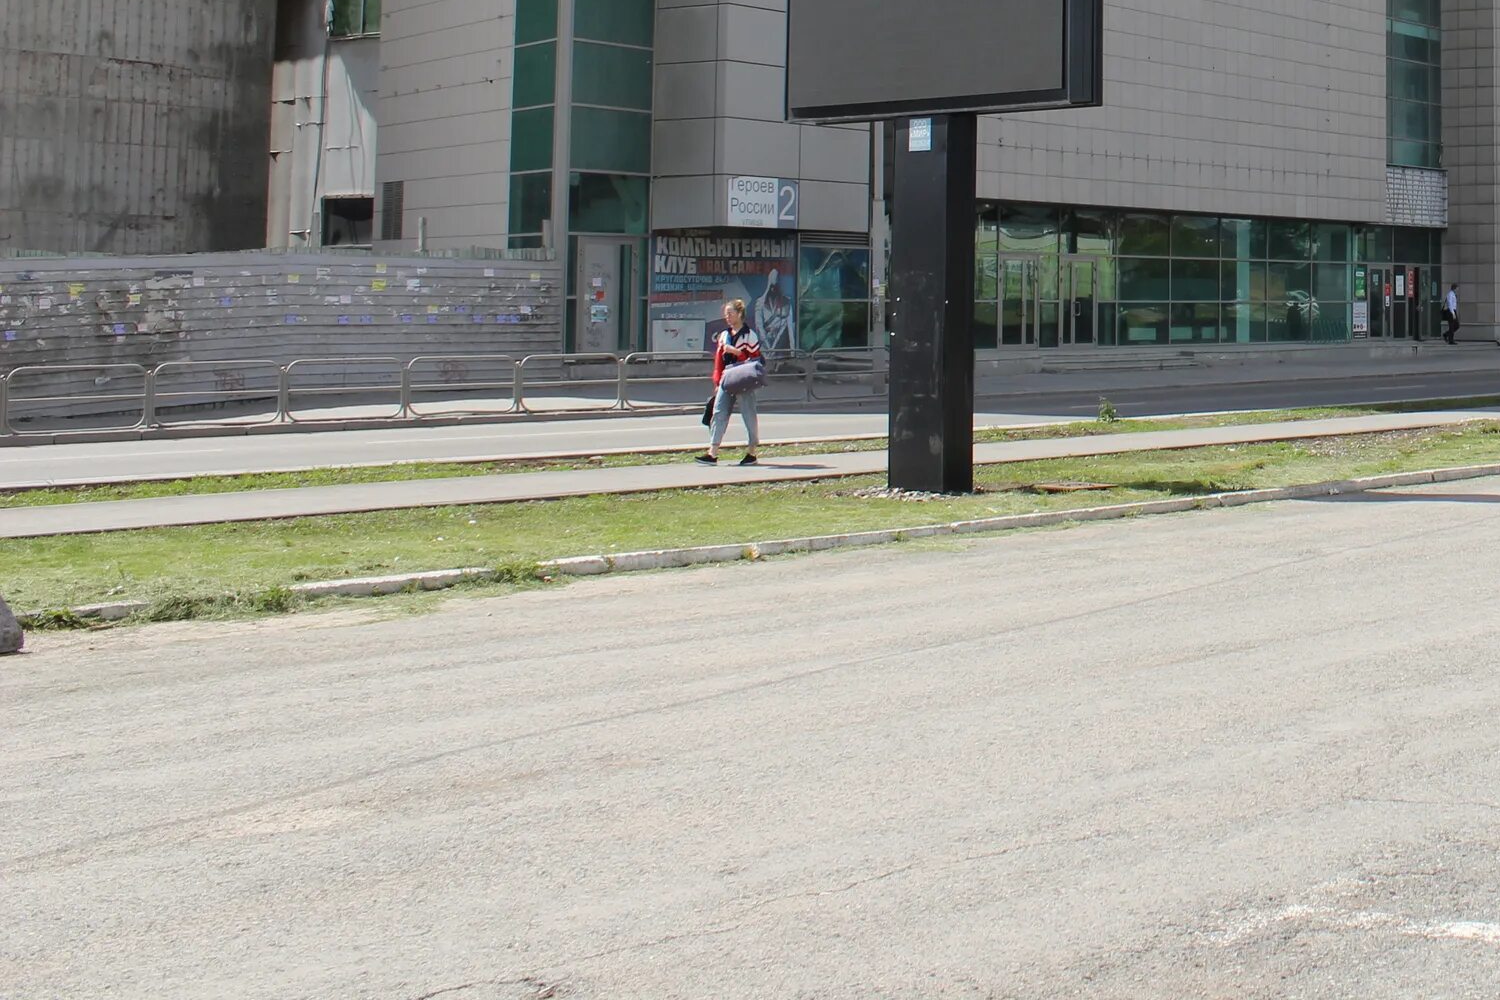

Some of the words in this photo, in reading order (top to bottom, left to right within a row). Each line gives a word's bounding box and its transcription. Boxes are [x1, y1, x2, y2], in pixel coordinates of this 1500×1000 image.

[731, 176, 775, 196] Героев
[730, 197, 775, 215] России
[779, 185, 796, 221] 2
[655, 255, 697, 275] КЛУБ
